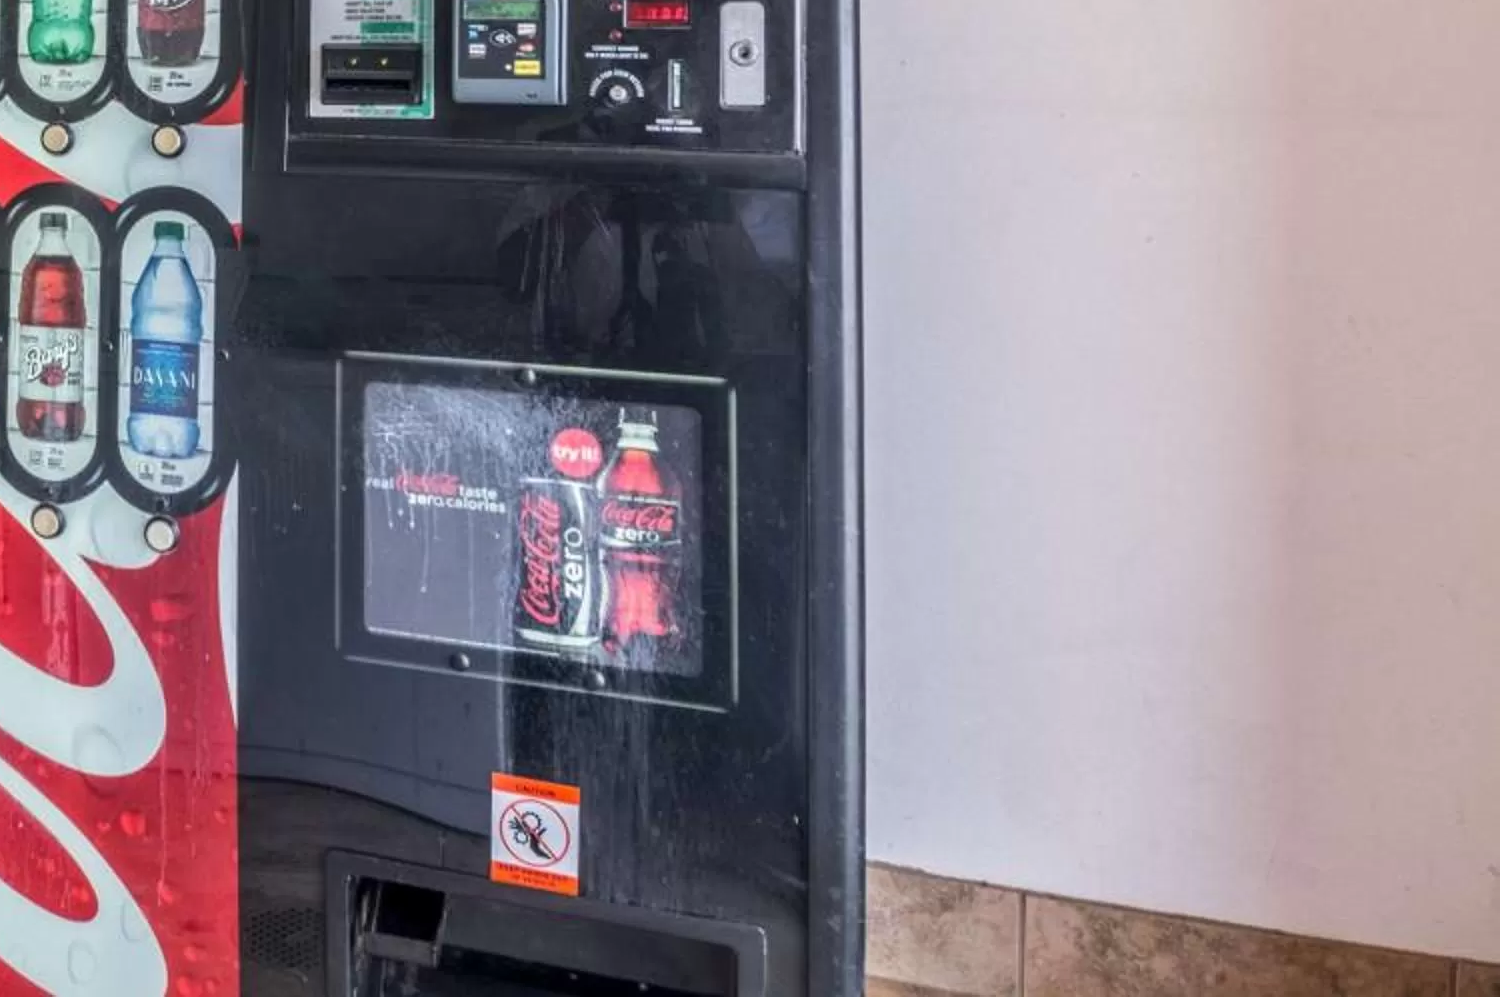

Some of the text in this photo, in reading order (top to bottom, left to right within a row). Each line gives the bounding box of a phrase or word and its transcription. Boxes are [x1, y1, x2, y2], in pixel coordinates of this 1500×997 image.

[25, 334, 77, 382] Barq's
[133, 367, 195, 390] DASANI
[553, 446, 577, 462] try
[365, 477, 395, 490] real
[460, 484, 498, 500] taste
[408, 493, 506, 513] zero calories
[602, 502, 676, 532] Coca-Cola
[614, 527, 660, 542] zero
[521, 494, 561, 625] Coca-Cola
[564, 527, 583, 598] zero
